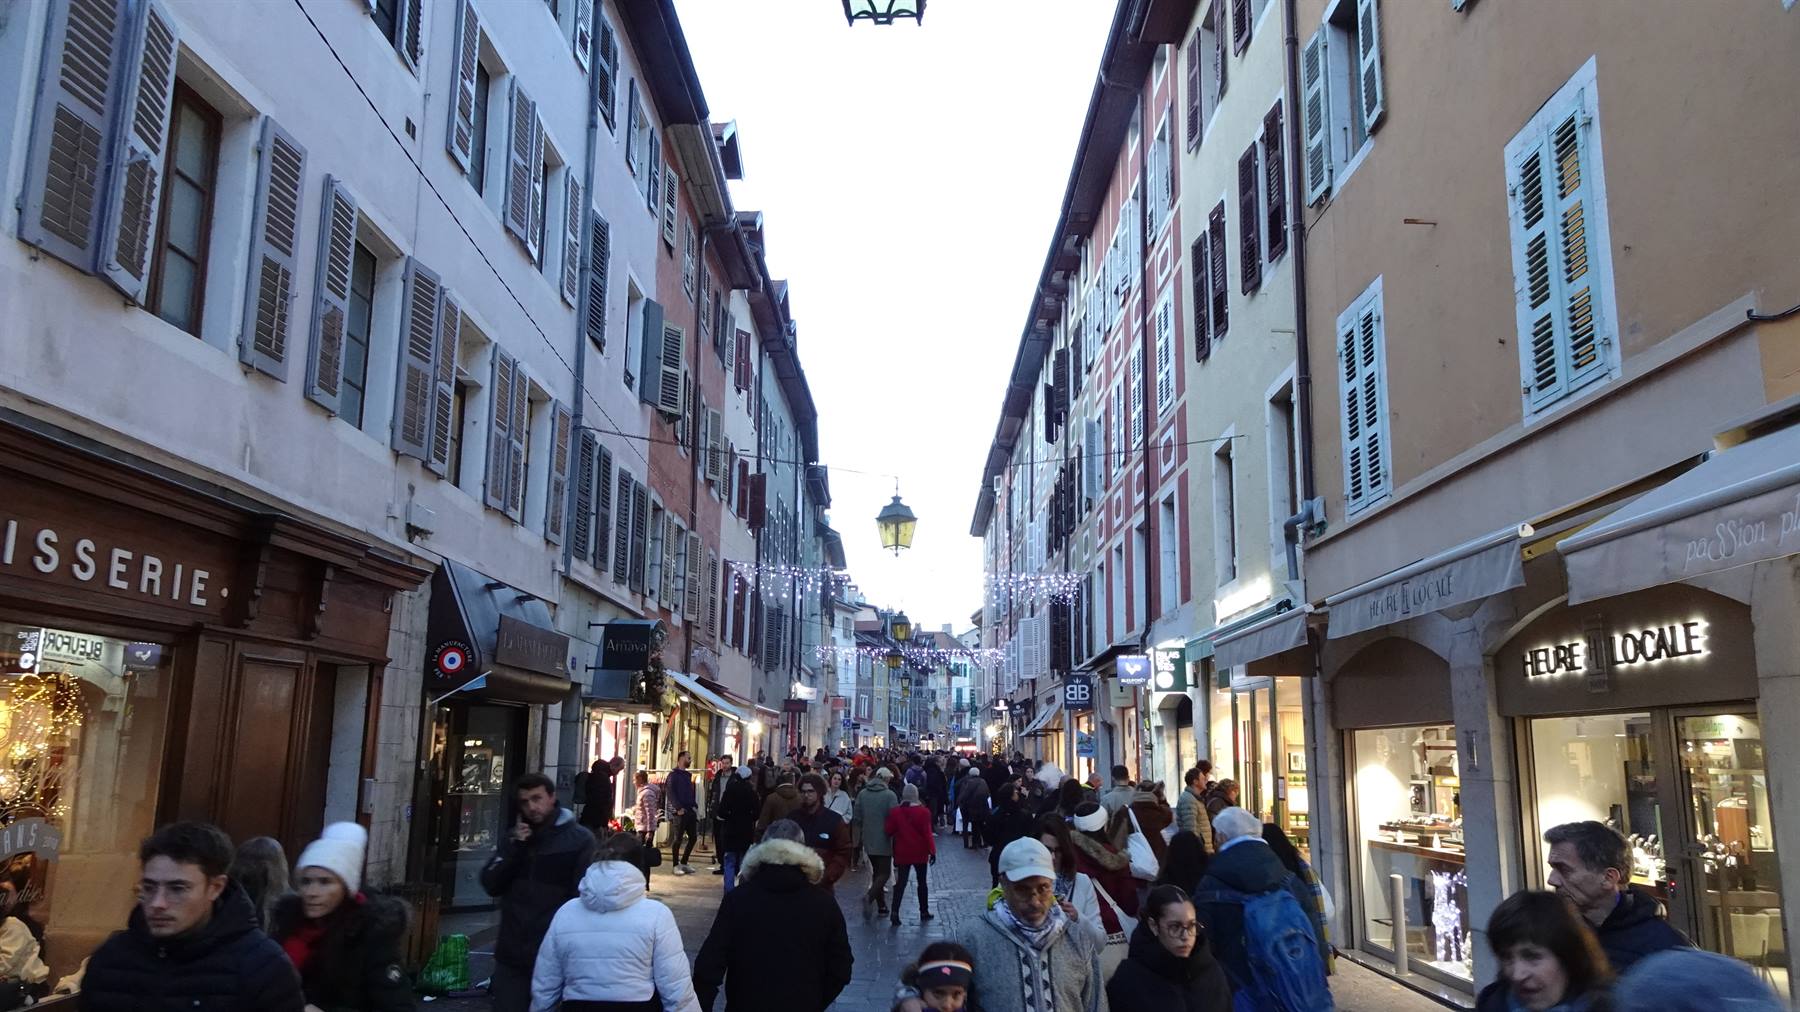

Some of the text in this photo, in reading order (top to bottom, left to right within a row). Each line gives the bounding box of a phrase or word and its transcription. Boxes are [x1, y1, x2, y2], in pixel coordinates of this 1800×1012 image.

[3, 519, 210, 606] ISSERIE
[1369, 575, 1454, 620] HEURE LOCALE
[1523, 621, 1703, 678] HEURE LOCALE
